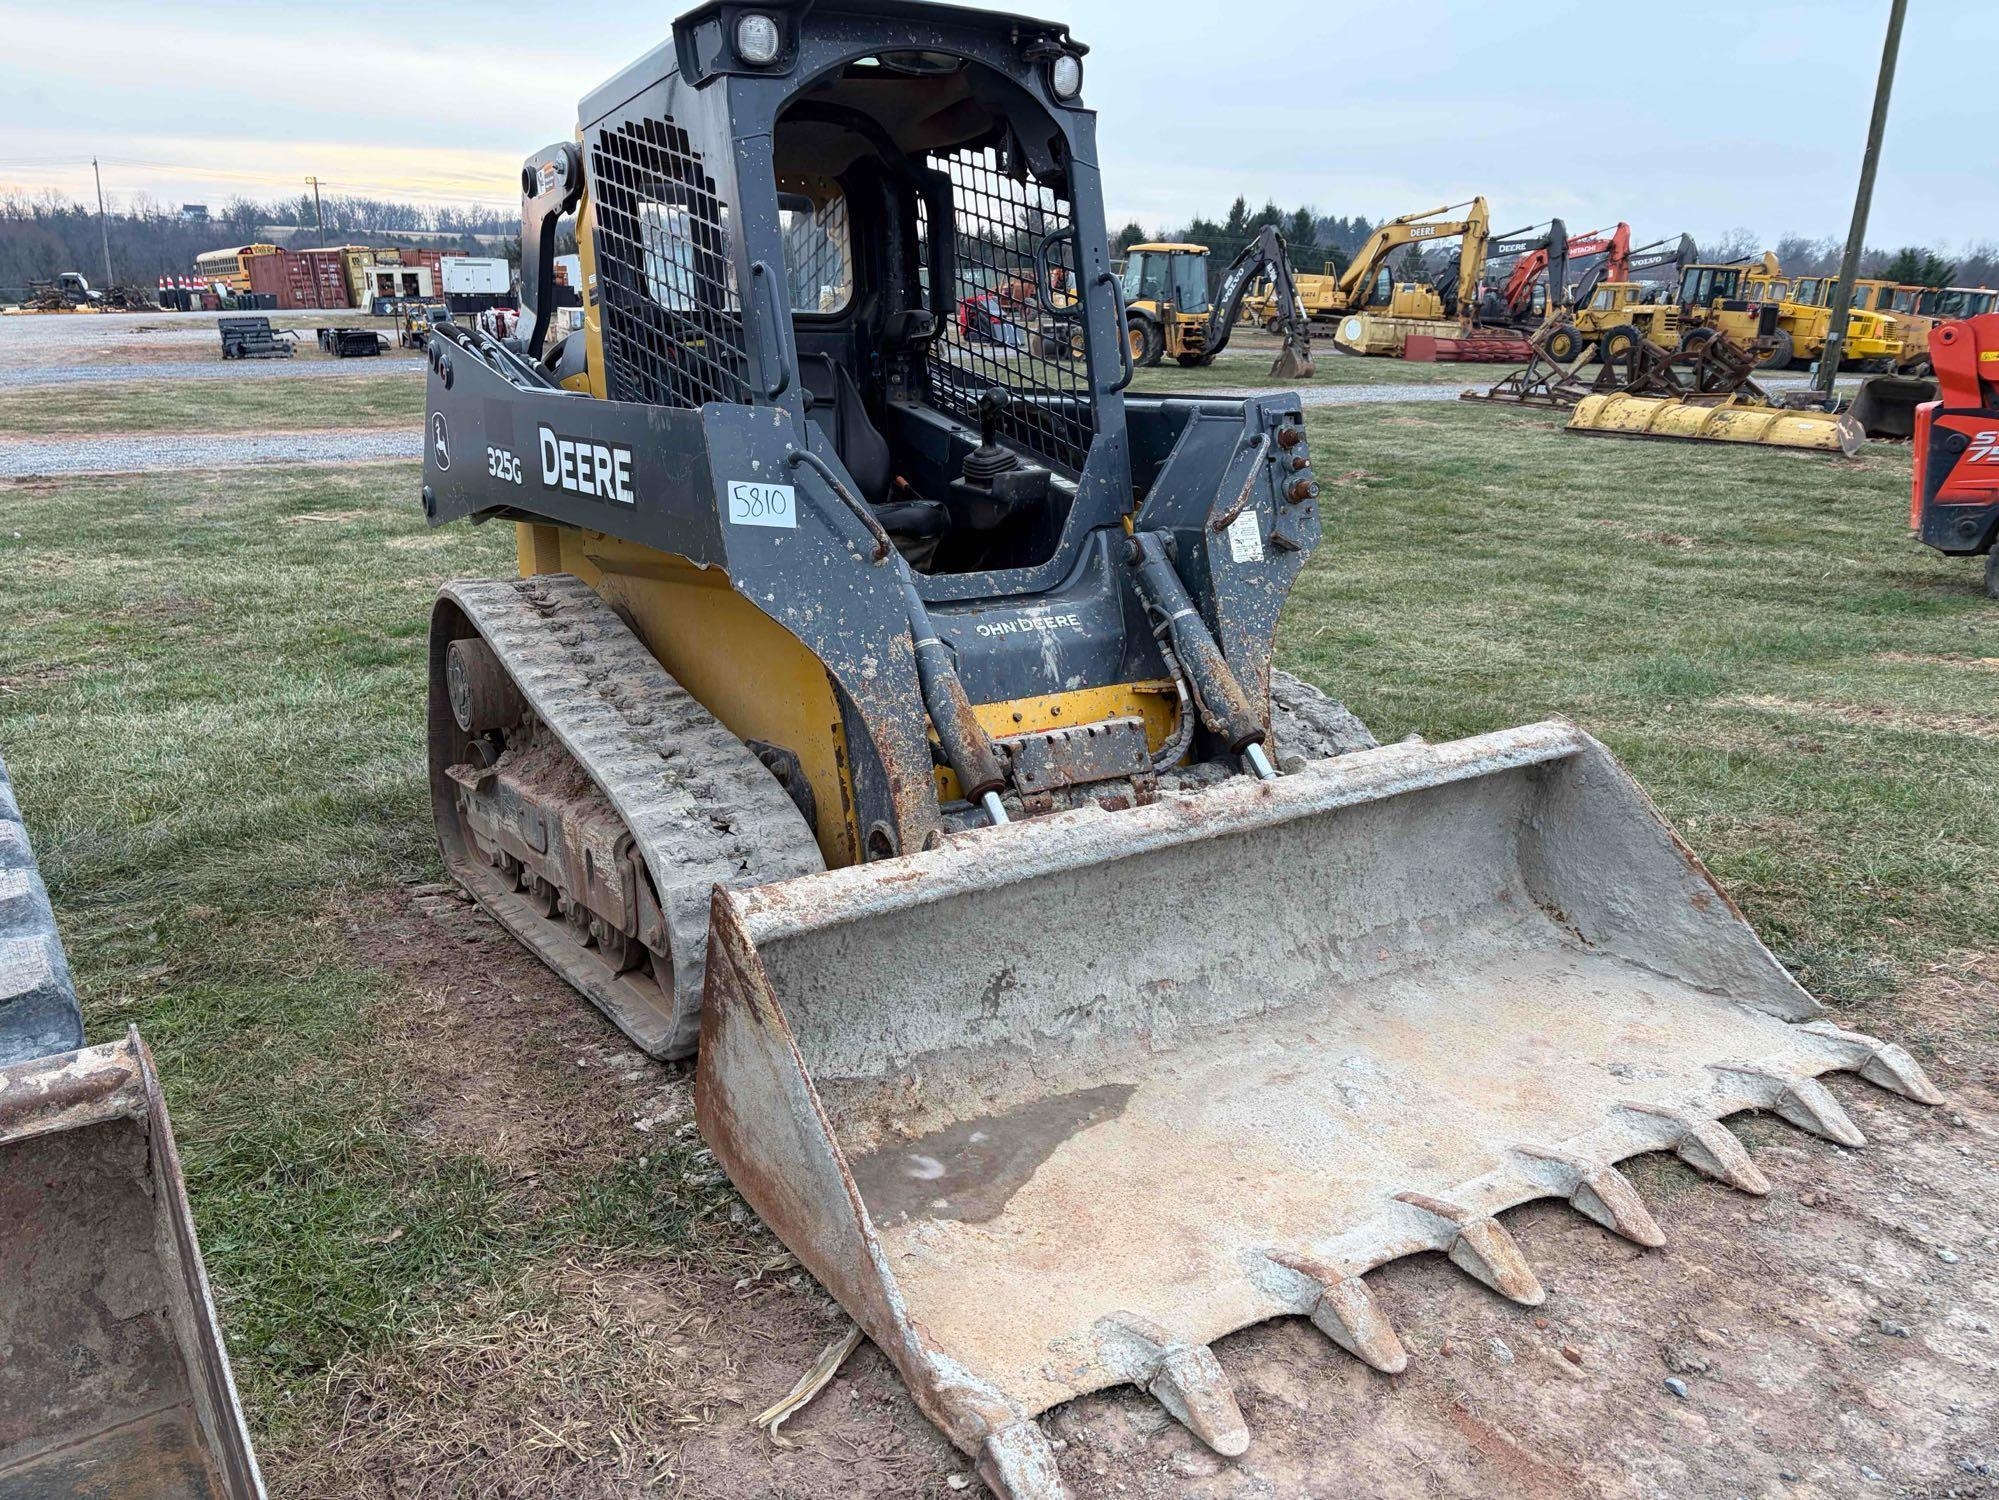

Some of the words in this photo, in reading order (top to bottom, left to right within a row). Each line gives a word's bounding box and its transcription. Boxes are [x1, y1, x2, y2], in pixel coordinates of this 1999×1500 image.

[1410, 226, 1436, 237] DEERE
[1498, 243, 1527, 253] DEERE
[1569, 245, 1596, 256] HITACHI
[1631, 256, 1662, 267] VOLVO
[1222, 268, 1244, 302] VOLVO
[487, 446, 522, 485] 325G
[539, 427, 634, 504] DEERE
[733, 485, 787, 517] 5810
[1017, 614, 1081, 632] DEERE
